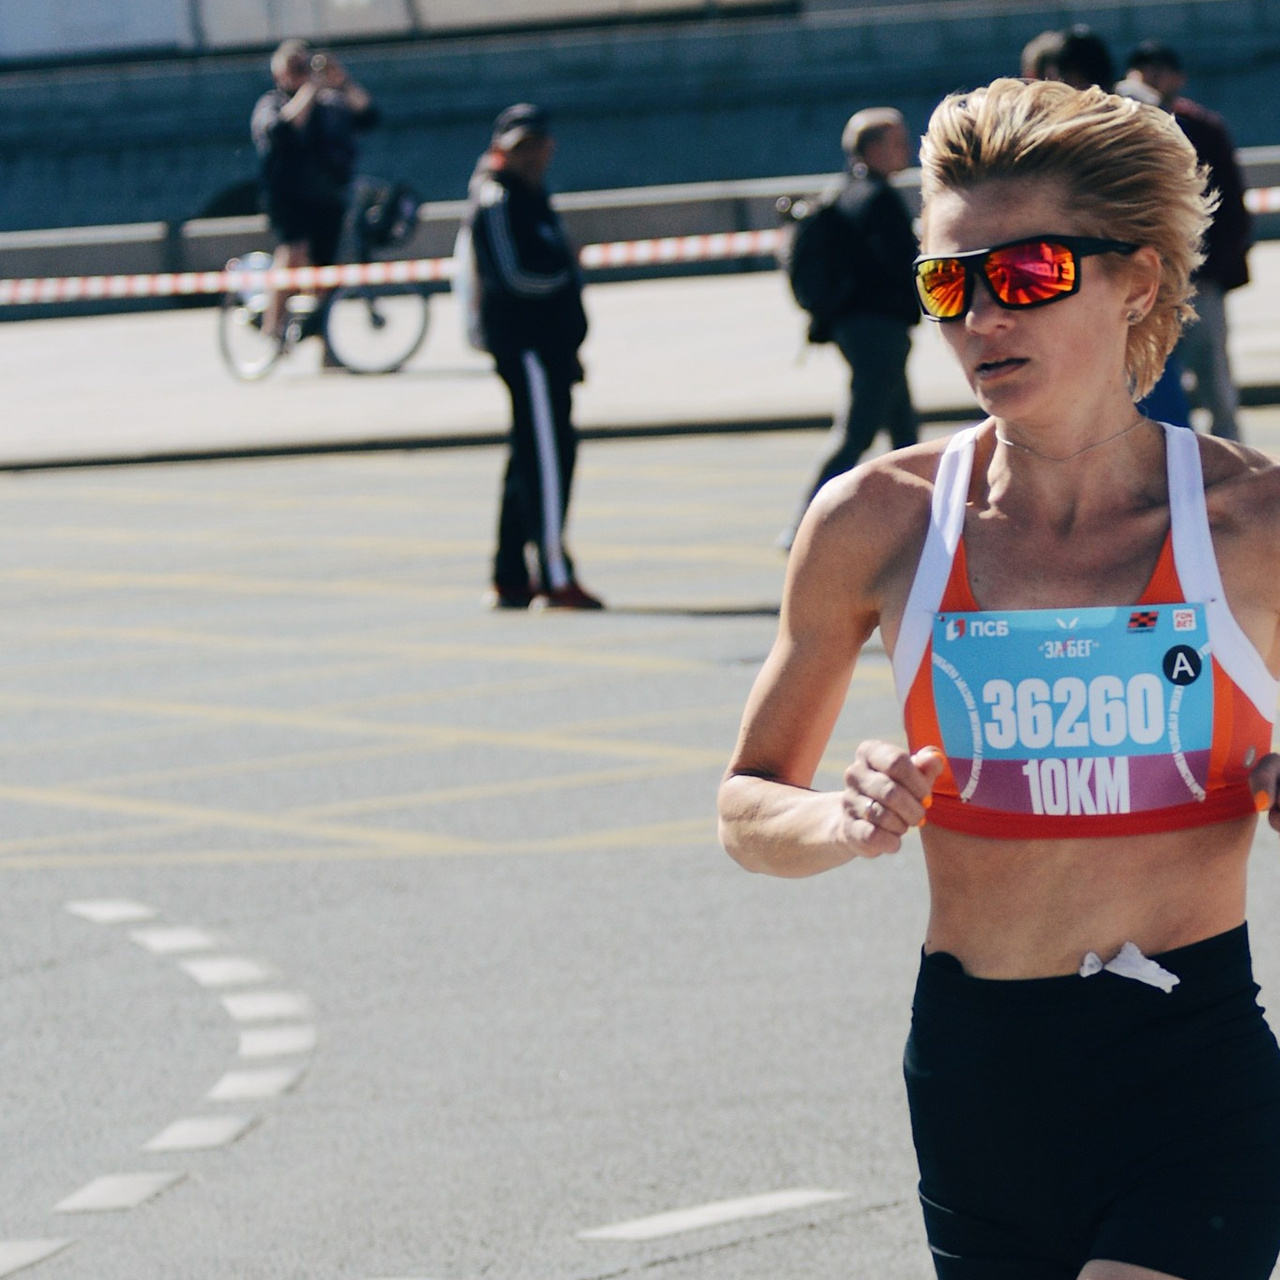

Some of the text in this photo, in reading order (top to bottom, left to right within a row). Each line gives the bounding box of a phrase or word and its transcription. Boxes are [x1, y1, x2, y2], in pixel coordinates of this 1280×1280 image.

[970, 620, 1009, 637] ПСБ
[1175, 612, 1193, 620] FON
[1172, 652, 1195, 680] A
[983, 673, 1165, 750] 36260
[1022, 756, 1131, 816] 10KM
